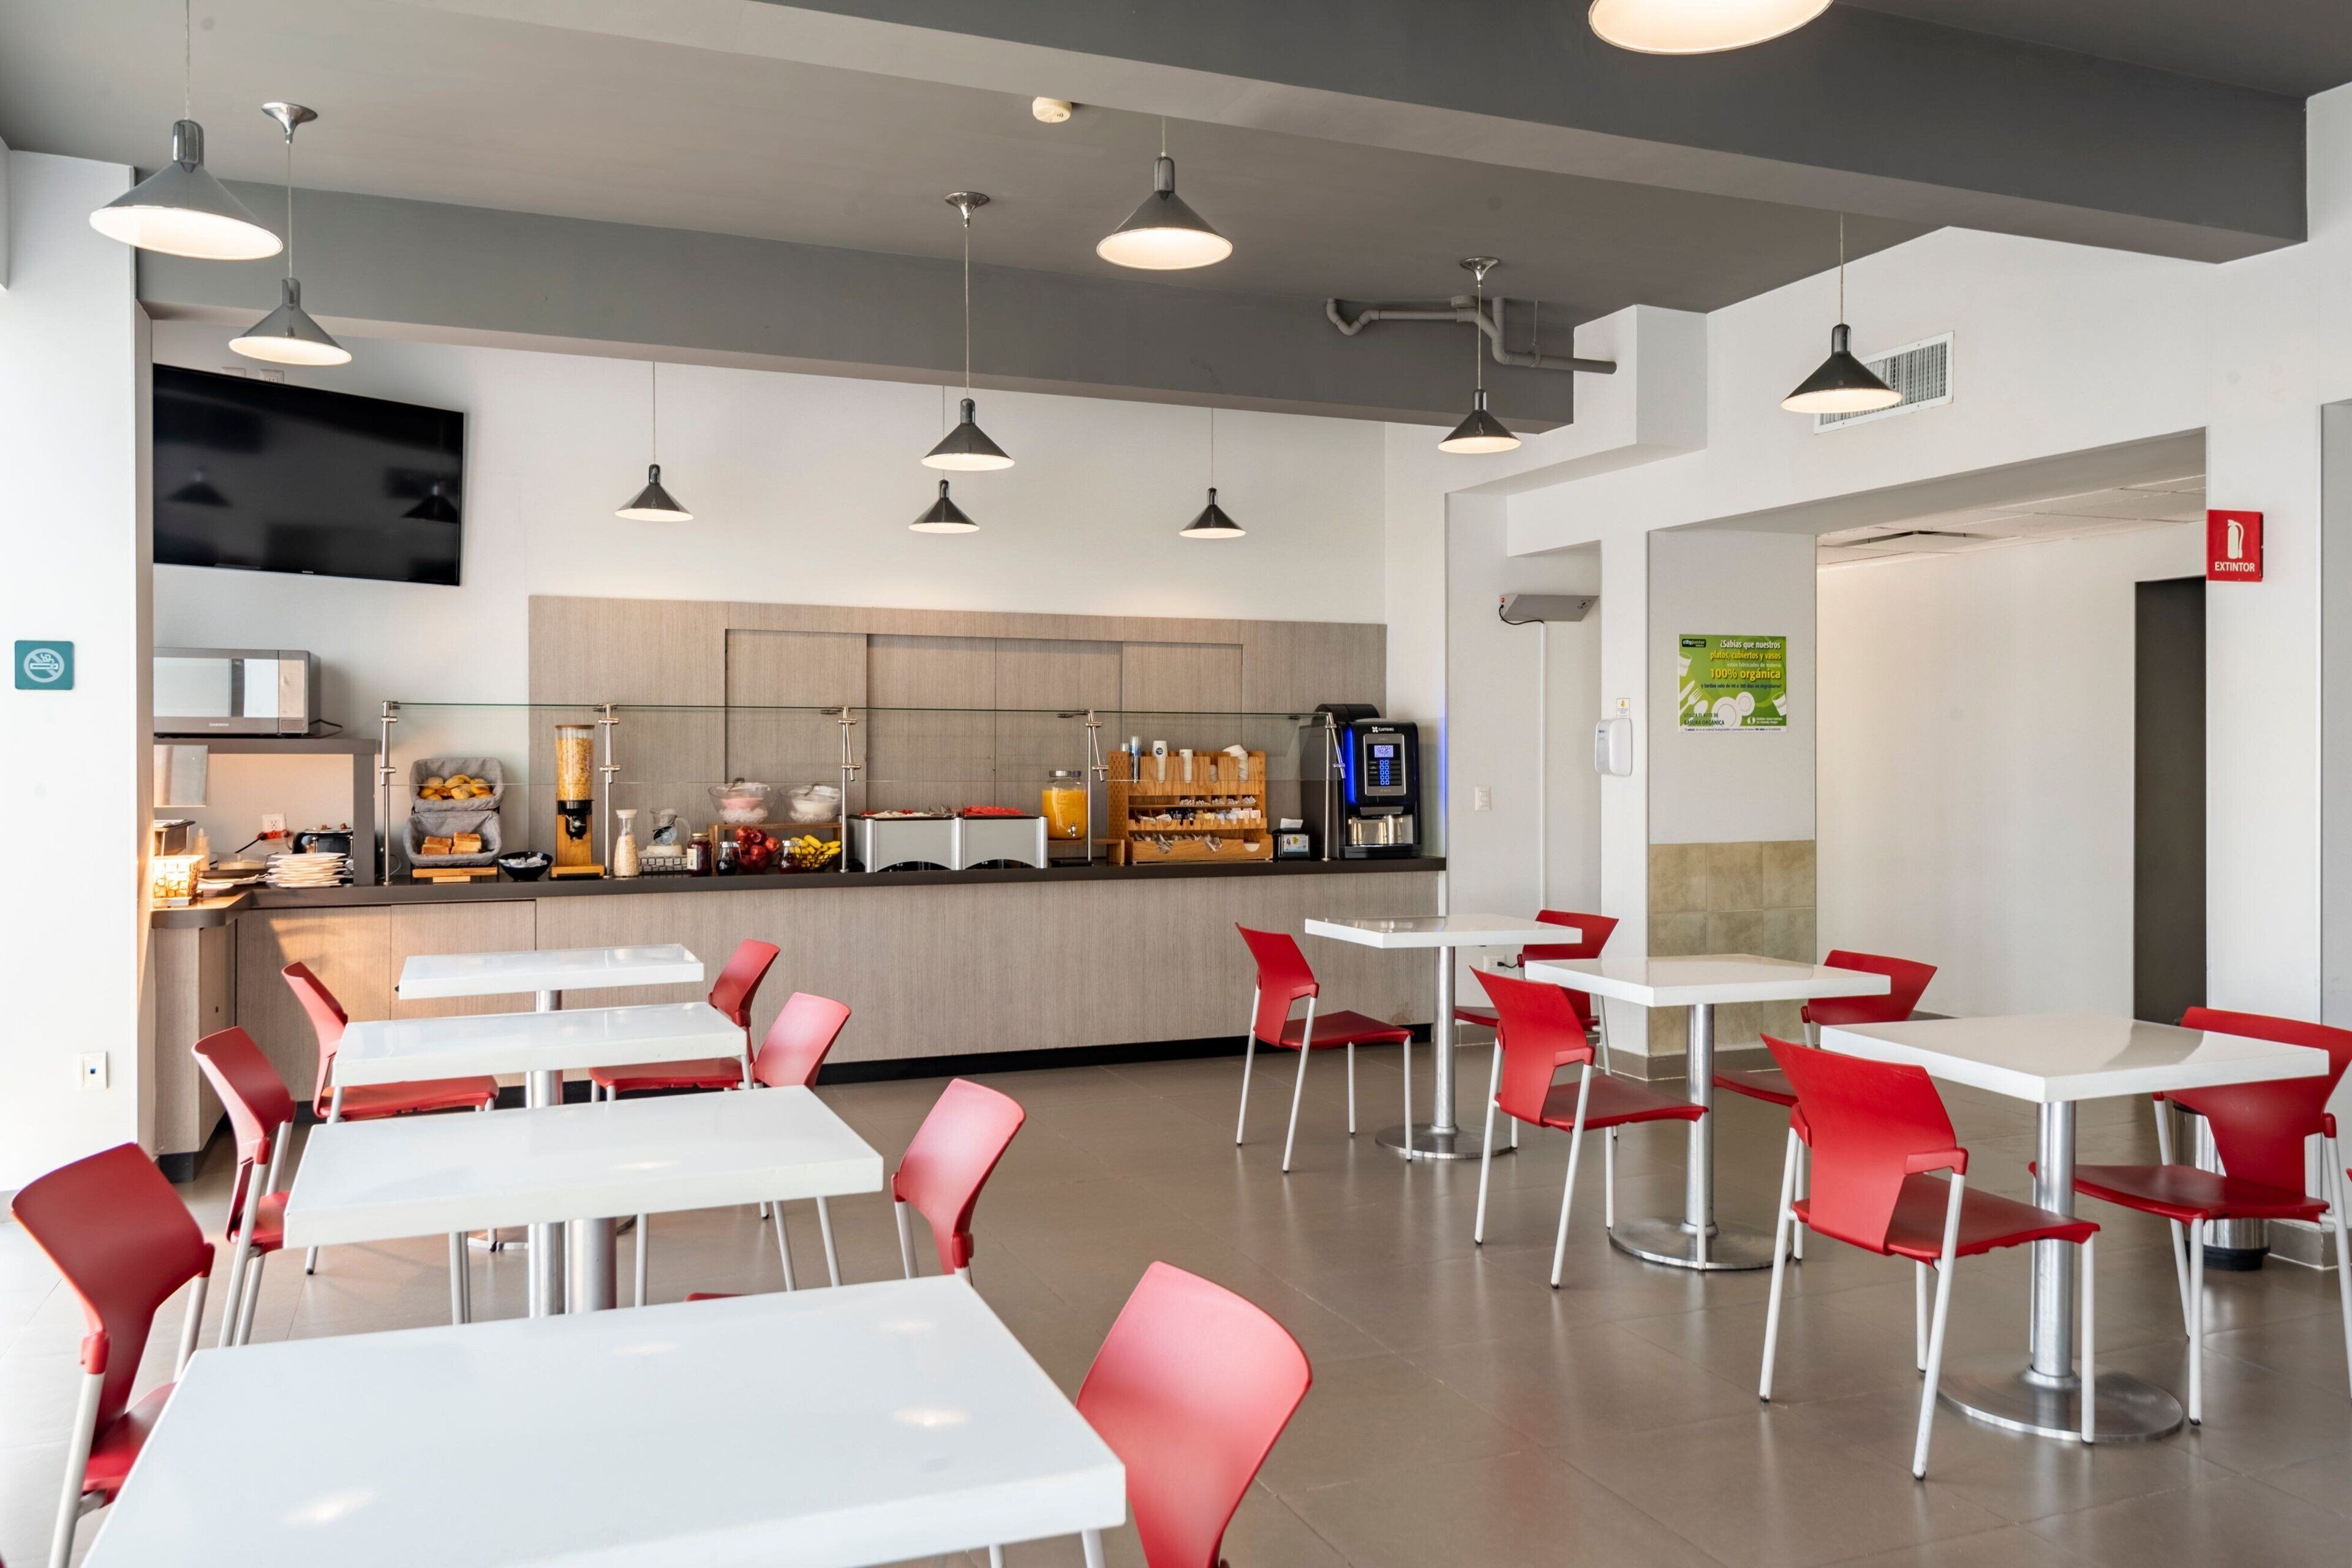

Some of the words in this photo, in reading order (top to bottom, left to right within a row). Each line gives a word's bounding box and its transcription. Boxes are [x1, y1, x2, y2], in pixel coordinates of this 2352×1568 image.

[2215, 562, 2255, 571] EXTINTOR
[1744, 641, 1754, 650] que
[1710, 651, 1730, 660] platos,
[1732, 651, 1758, 660] cubiertos
[1710, 669, 1737, 679] 100%
[1740, 668, 1781, 681] orgánica
